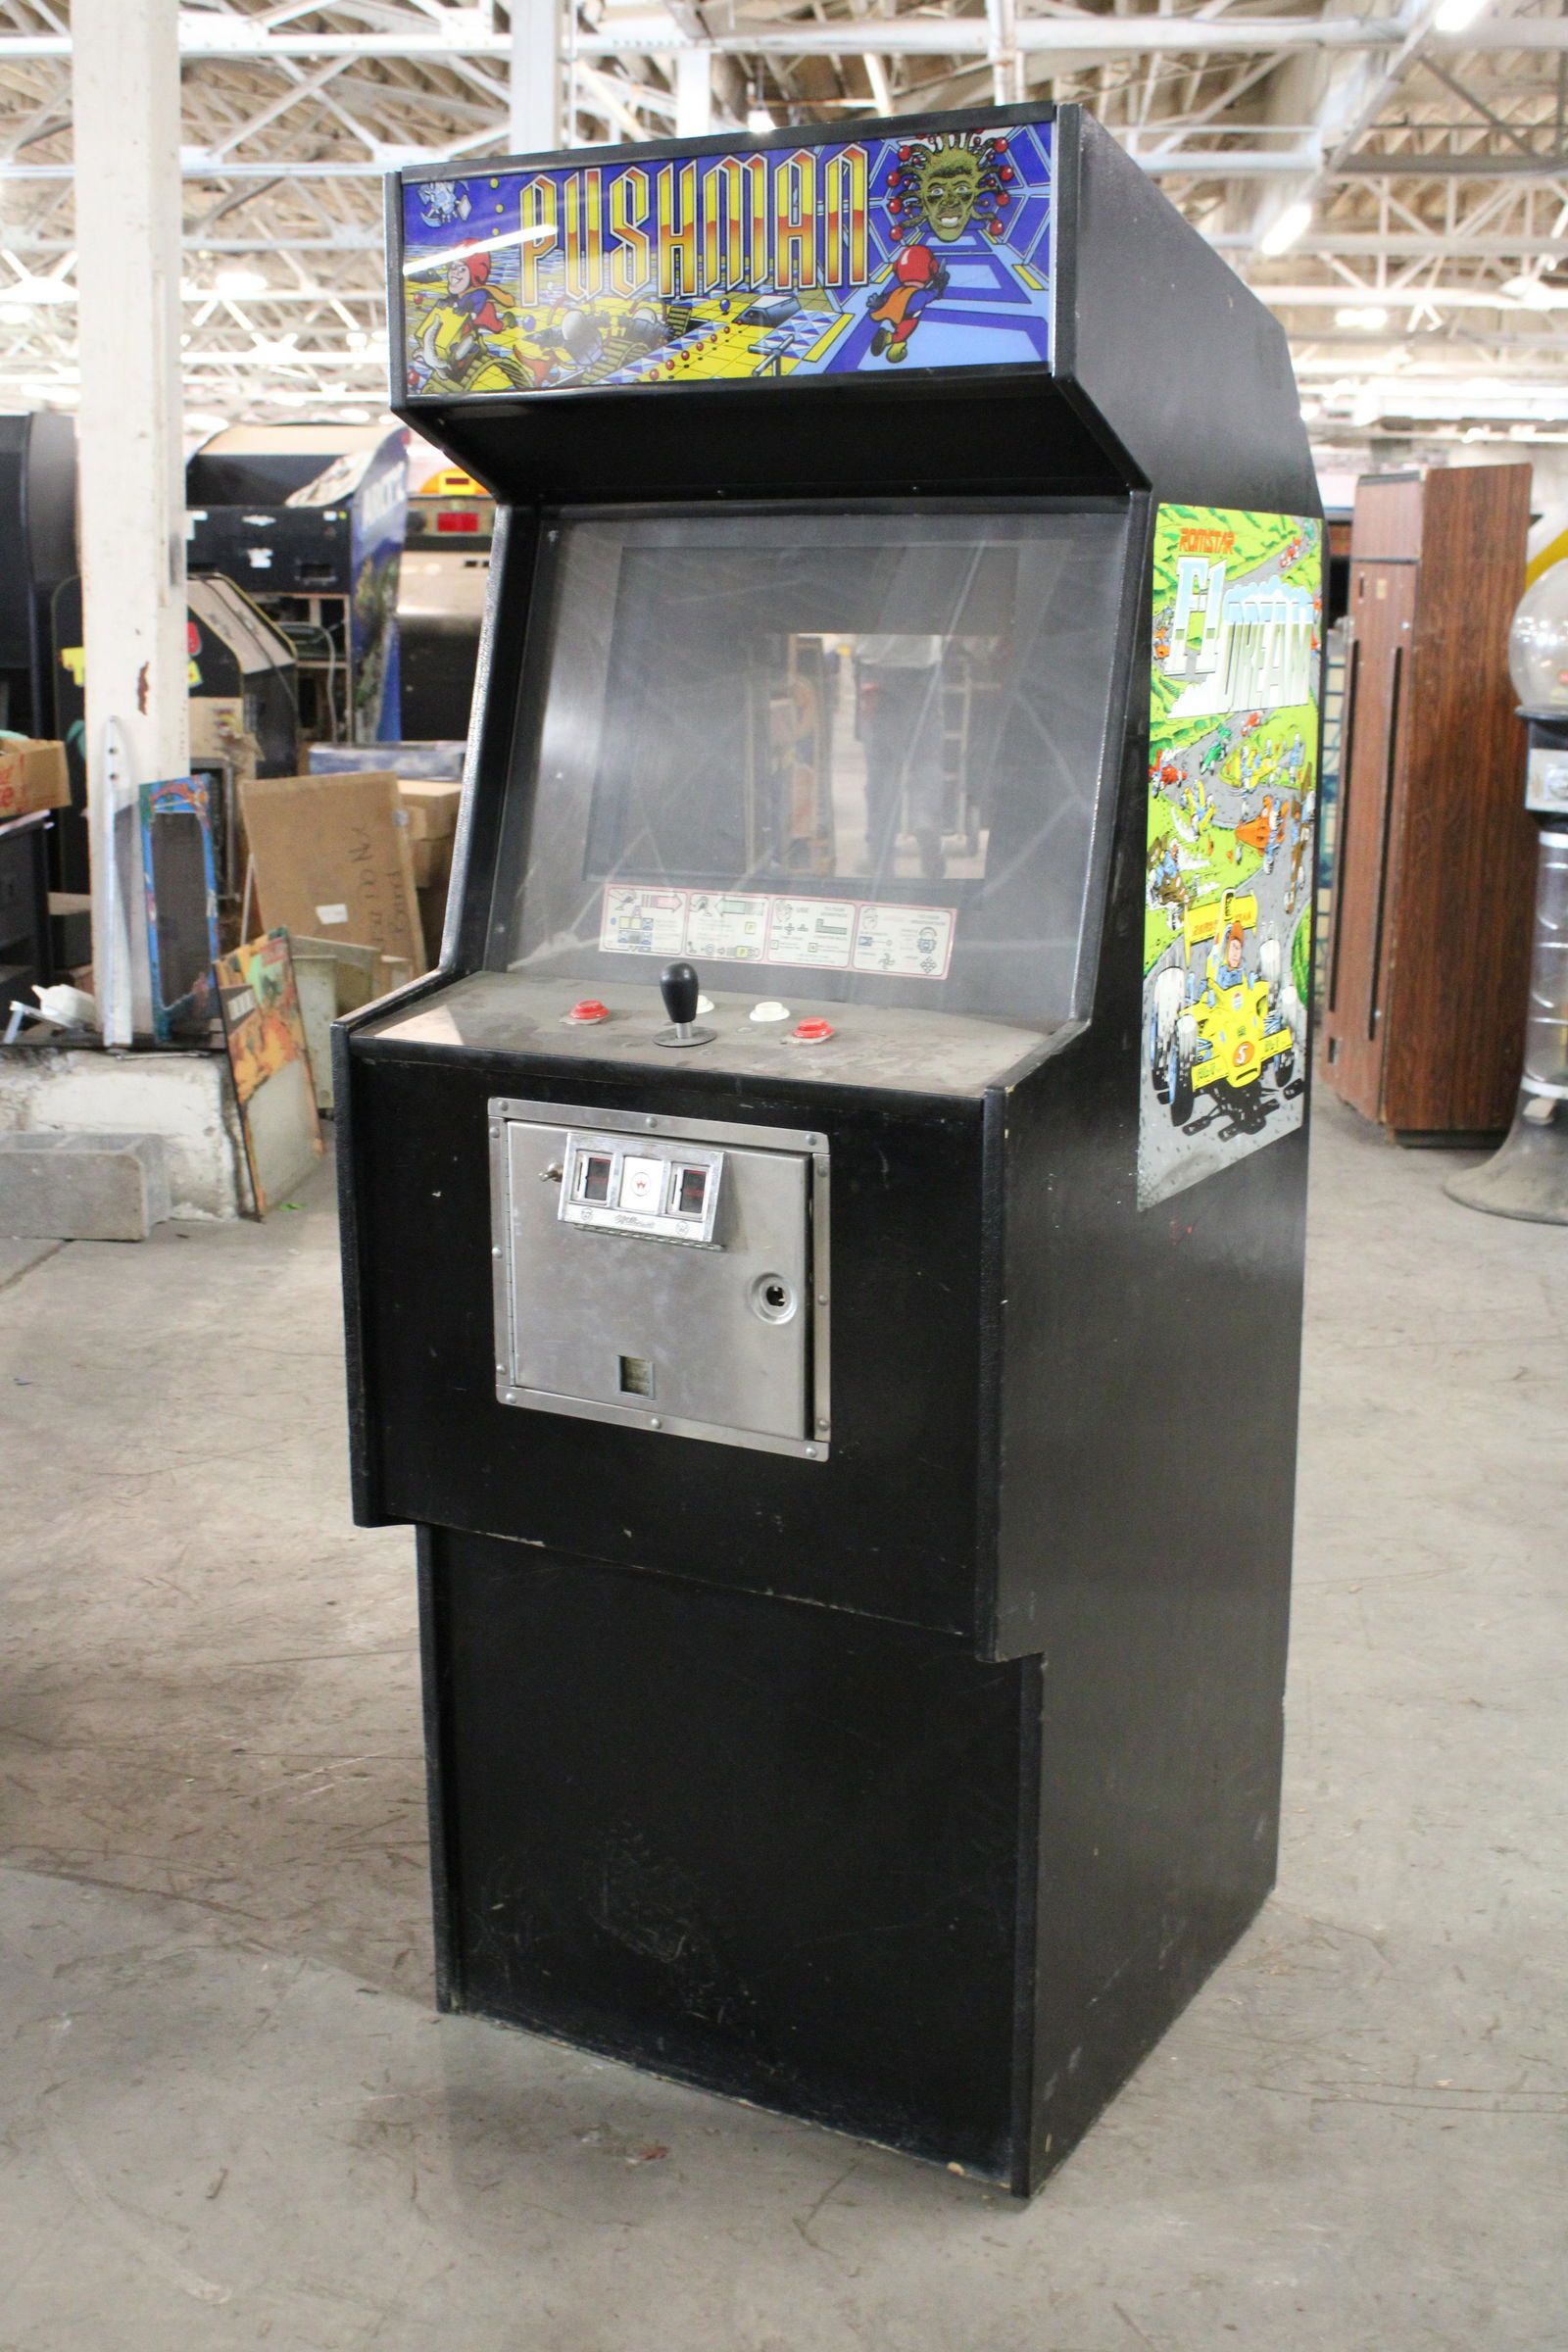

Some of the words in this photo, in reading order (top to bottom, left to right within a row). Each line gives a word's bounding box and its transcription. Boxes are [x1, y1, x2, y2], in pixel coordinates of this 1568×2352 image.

[519, 142, 868, 308] PUSHMAN
[1179, 527, 1236, 555] ROMSTAR
[1164, 556, 1227, 676] F1
